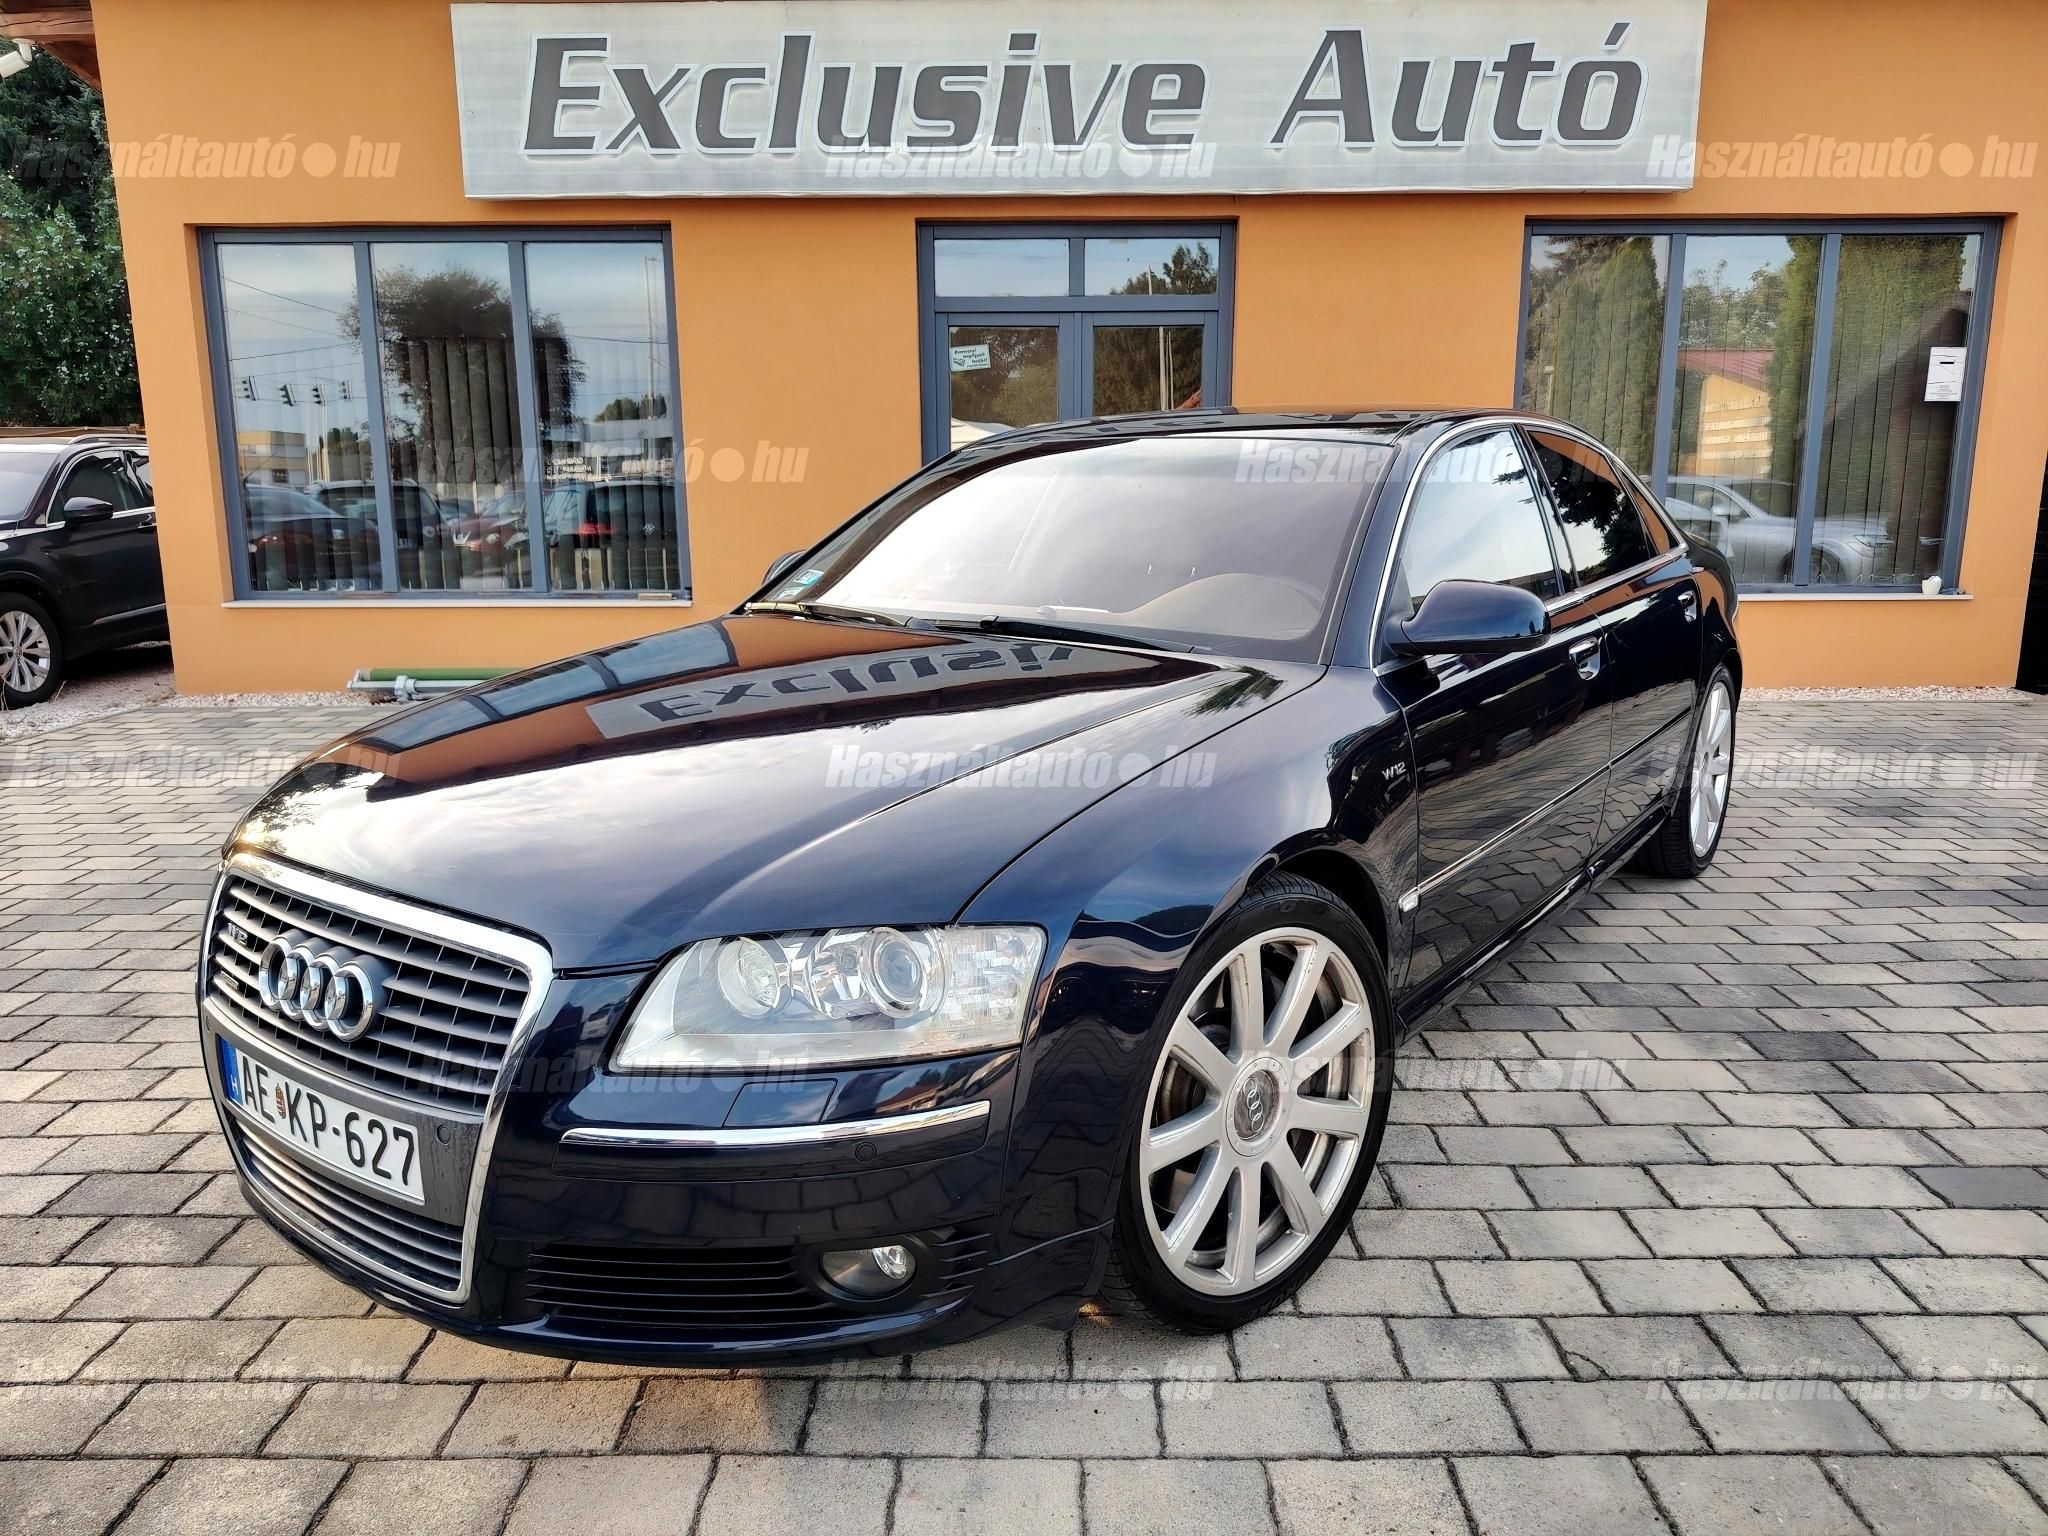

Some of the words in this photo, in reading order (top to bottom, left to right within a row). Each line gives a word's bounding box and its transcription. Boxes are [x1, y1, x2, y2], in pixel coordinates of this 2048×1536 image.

[519, 29, 1209, 154] Exclusive
[1264, 19, 1649, 149] Autó
[1381, 761, 1407, 780] W12
